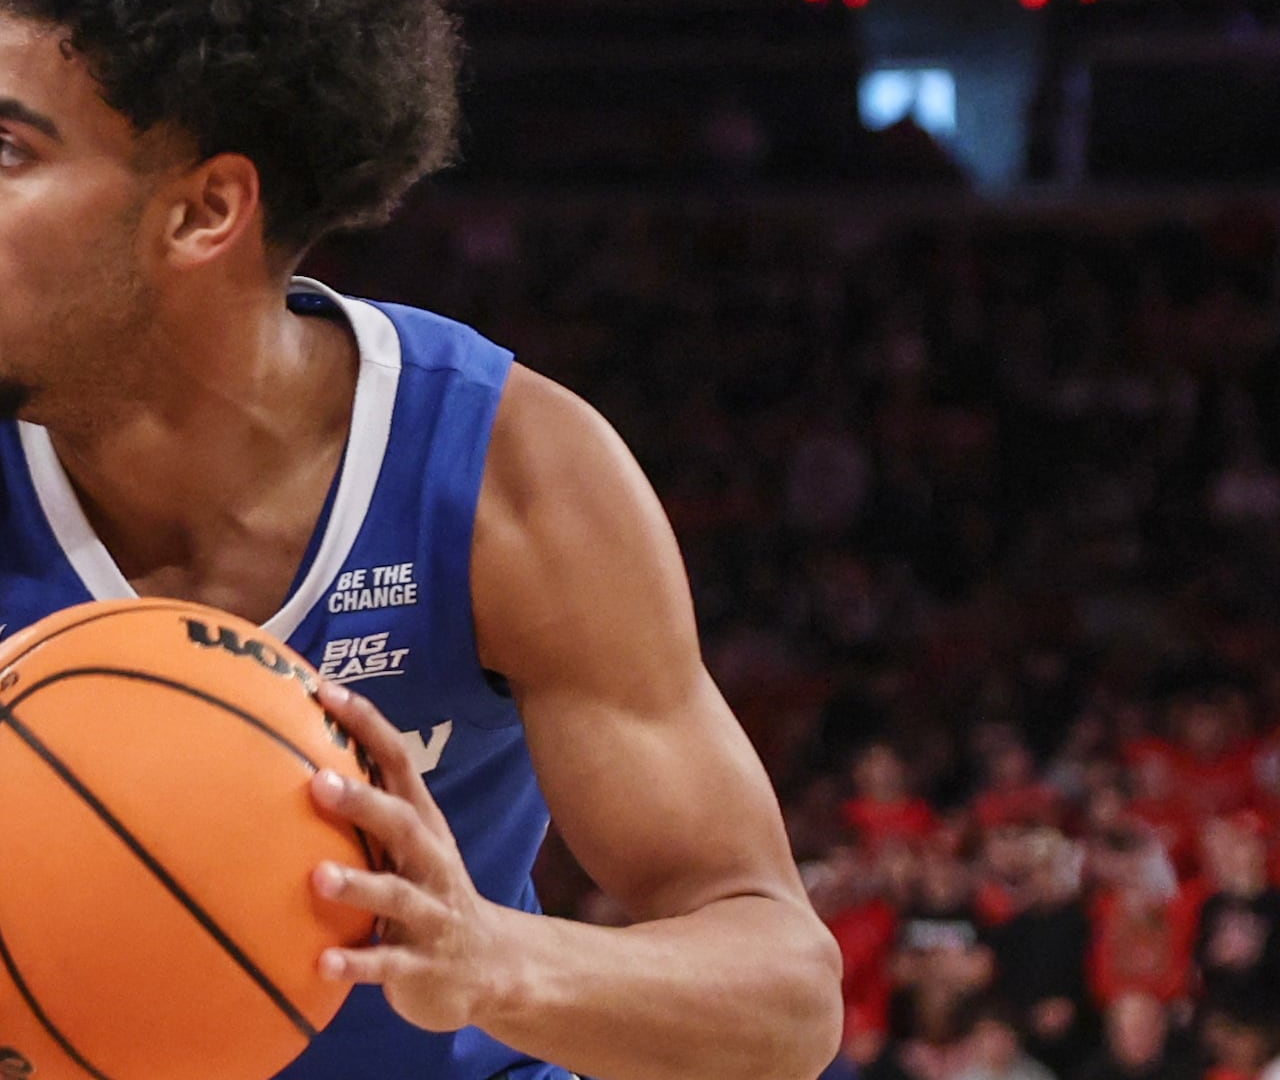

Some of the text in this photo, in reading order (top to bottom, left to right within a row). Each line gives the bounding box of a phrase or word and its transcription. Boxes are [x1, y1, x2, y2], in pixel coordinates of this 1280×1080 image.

[336, 562, 414, 591] BE THE
[328, 583, 418, 614] CHANGE
[322, 631, 390, 662] BIG
[319, 648, 410, 680] EAST
